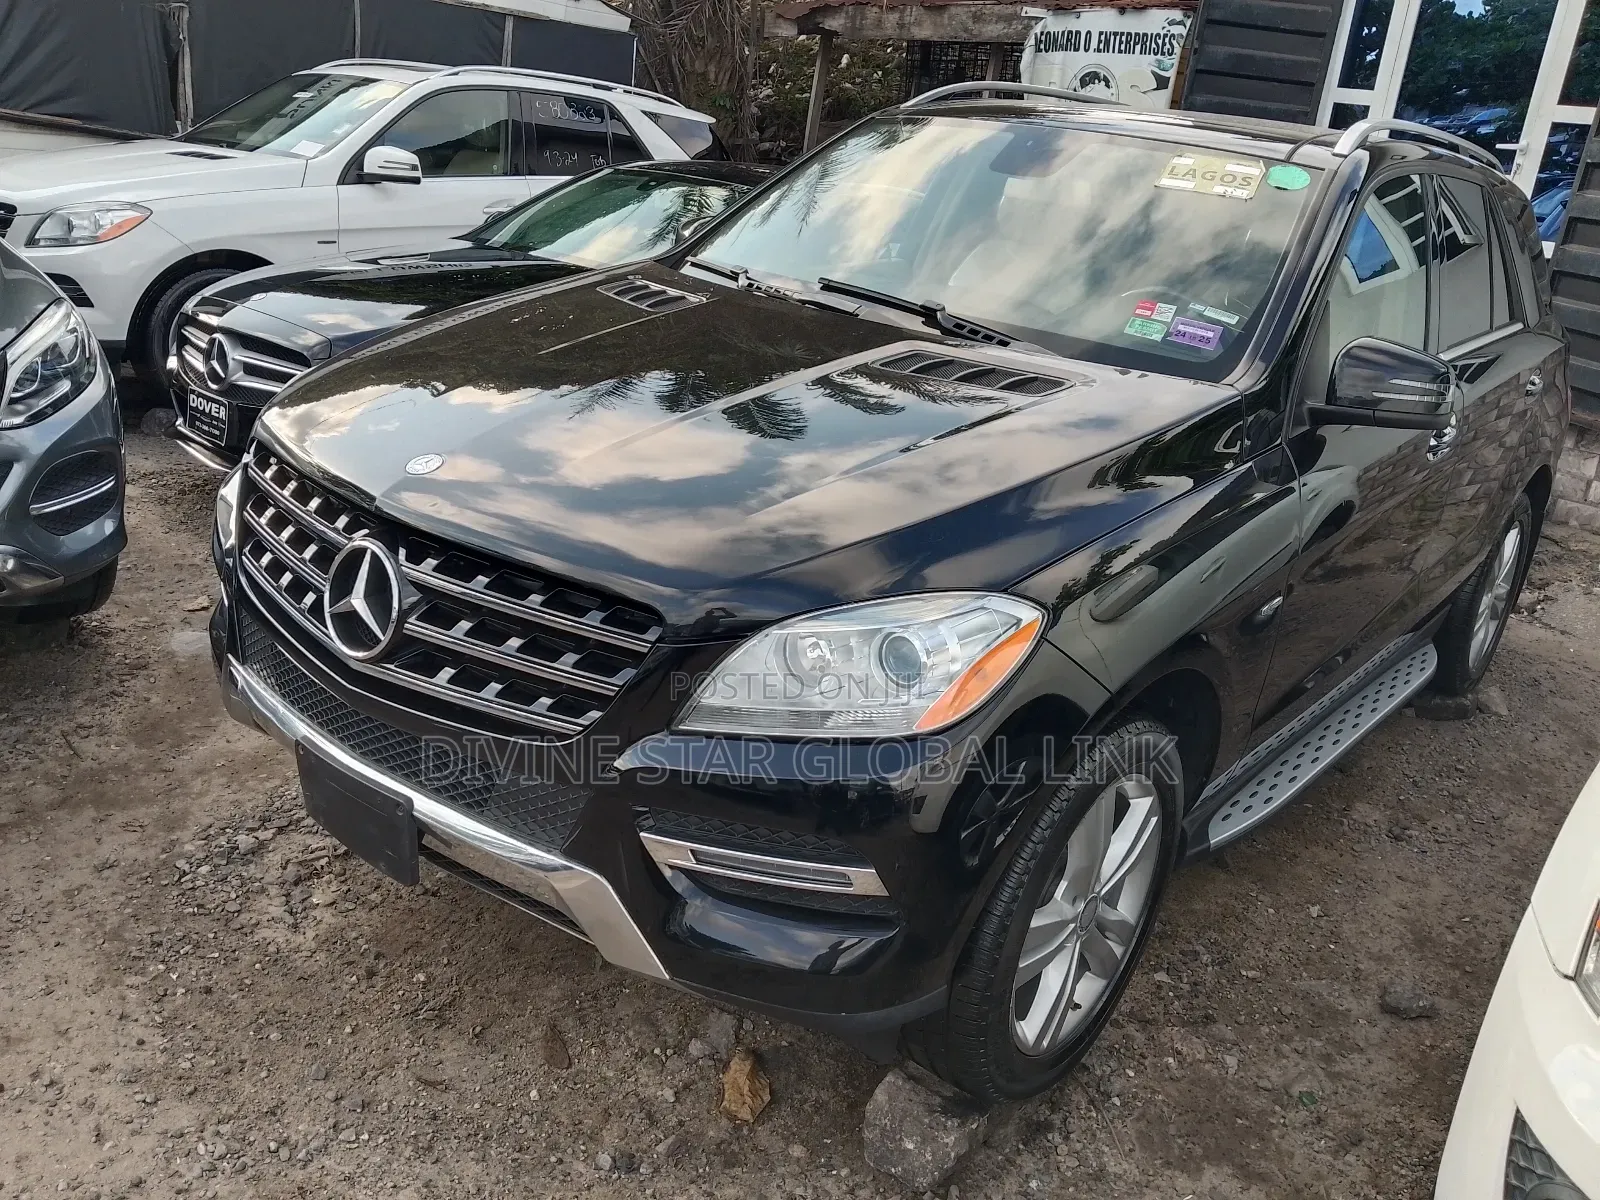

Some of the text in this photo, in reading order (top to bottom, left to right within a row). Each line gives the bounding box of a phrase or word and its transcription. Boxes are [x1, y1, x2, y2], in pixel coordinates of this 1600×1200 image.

[1083, 29, 1092, 53] O
[1167, 165, 1253, 187] LAGOS
[1174, 329, 1186, 338] 24
[1198, 336, 1212, 345] 25
[190, 393, 226, 421] DOVER
